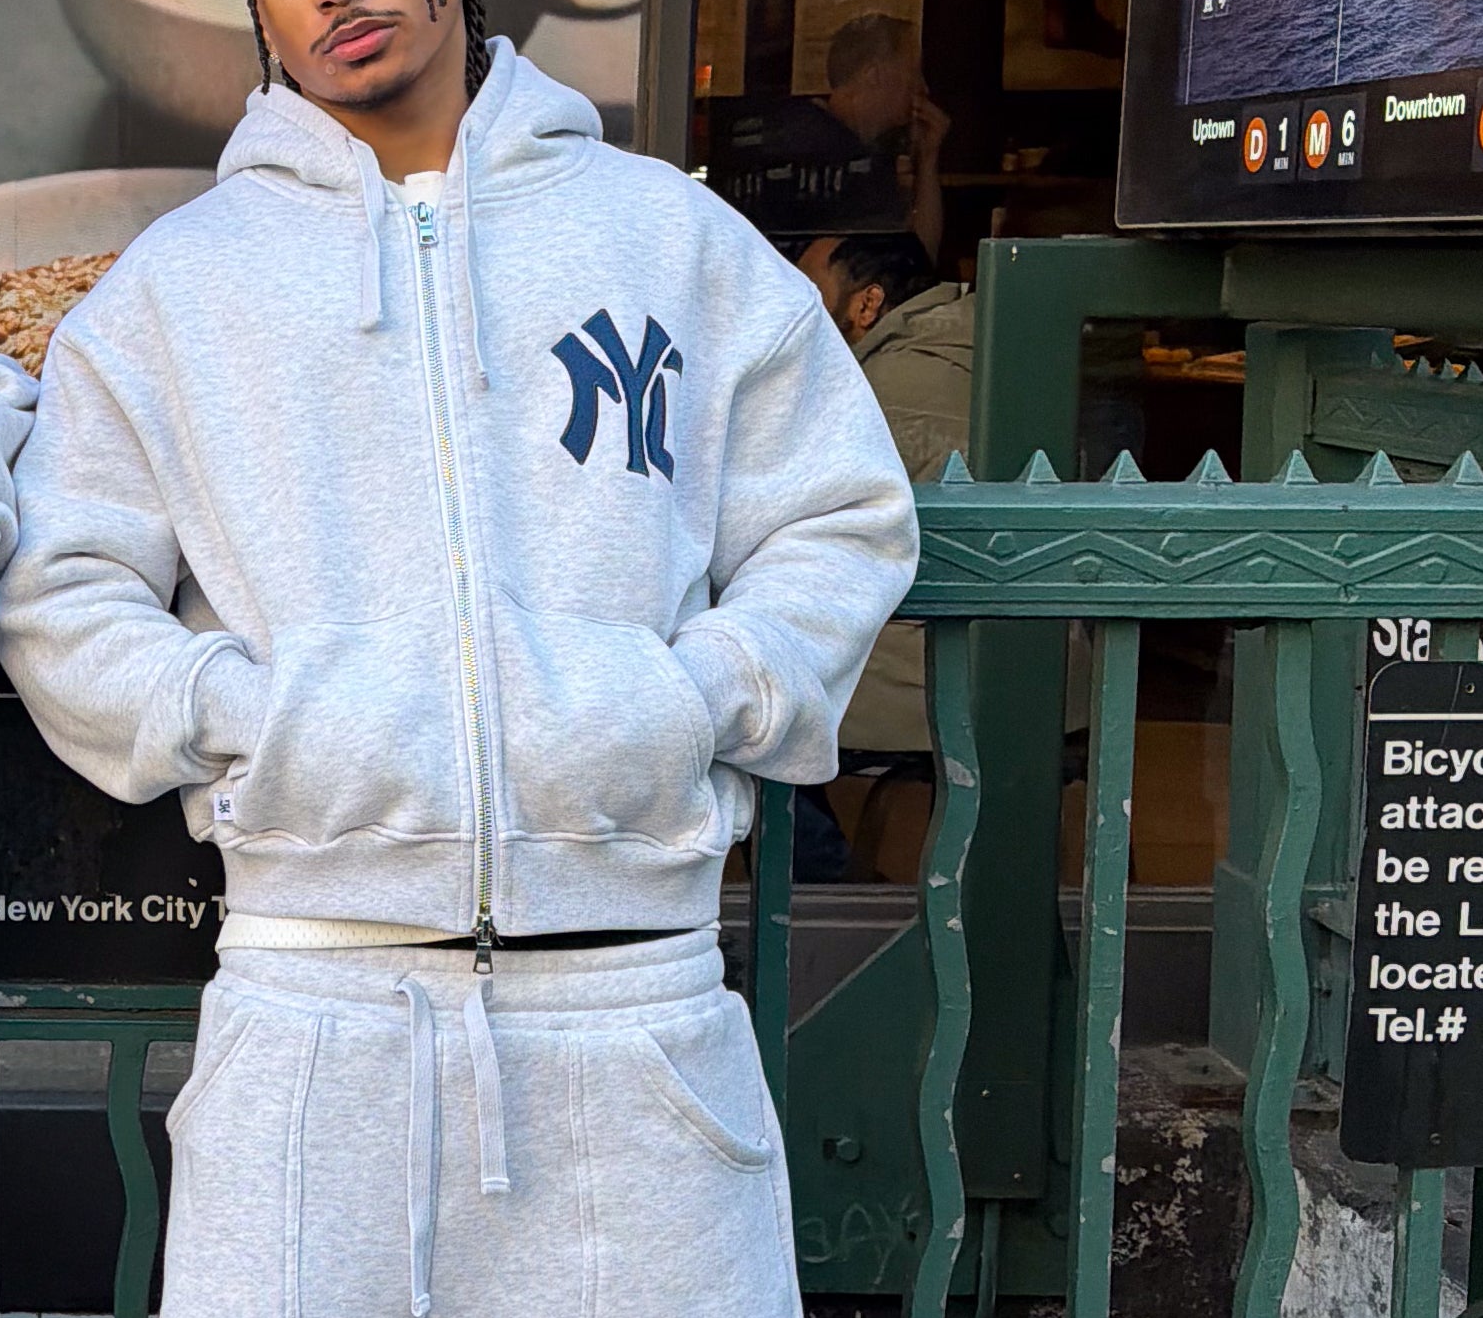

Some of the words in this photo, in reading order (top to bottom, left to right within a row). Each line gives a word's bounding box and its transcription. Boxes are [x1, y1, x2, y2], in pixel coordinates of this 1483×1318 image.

[1192, 118, 1235, 145] Uptown
[1249, 129, 1263, 161] D
[1278, 117, 1288, 152] 1
[1309, 122, 1327, 156] M
[1342, 109, 1356, 147] 6
[1384, 92, 1466, 122] Downtown
[1274, 157, 1289, 170] MIN
[1338, 152, 1355, 167] MIN
[1376, 848, 1430, 883] be
[1448, 856, 1483, 883] re
[60, 895, 133, 922] York
[141, 895, 206, 929] City
[1374, 902, 1441, 937] the
[1459, 902, 1483, 936] L
[1367, 1007, 1467, 1042] Tel.#
